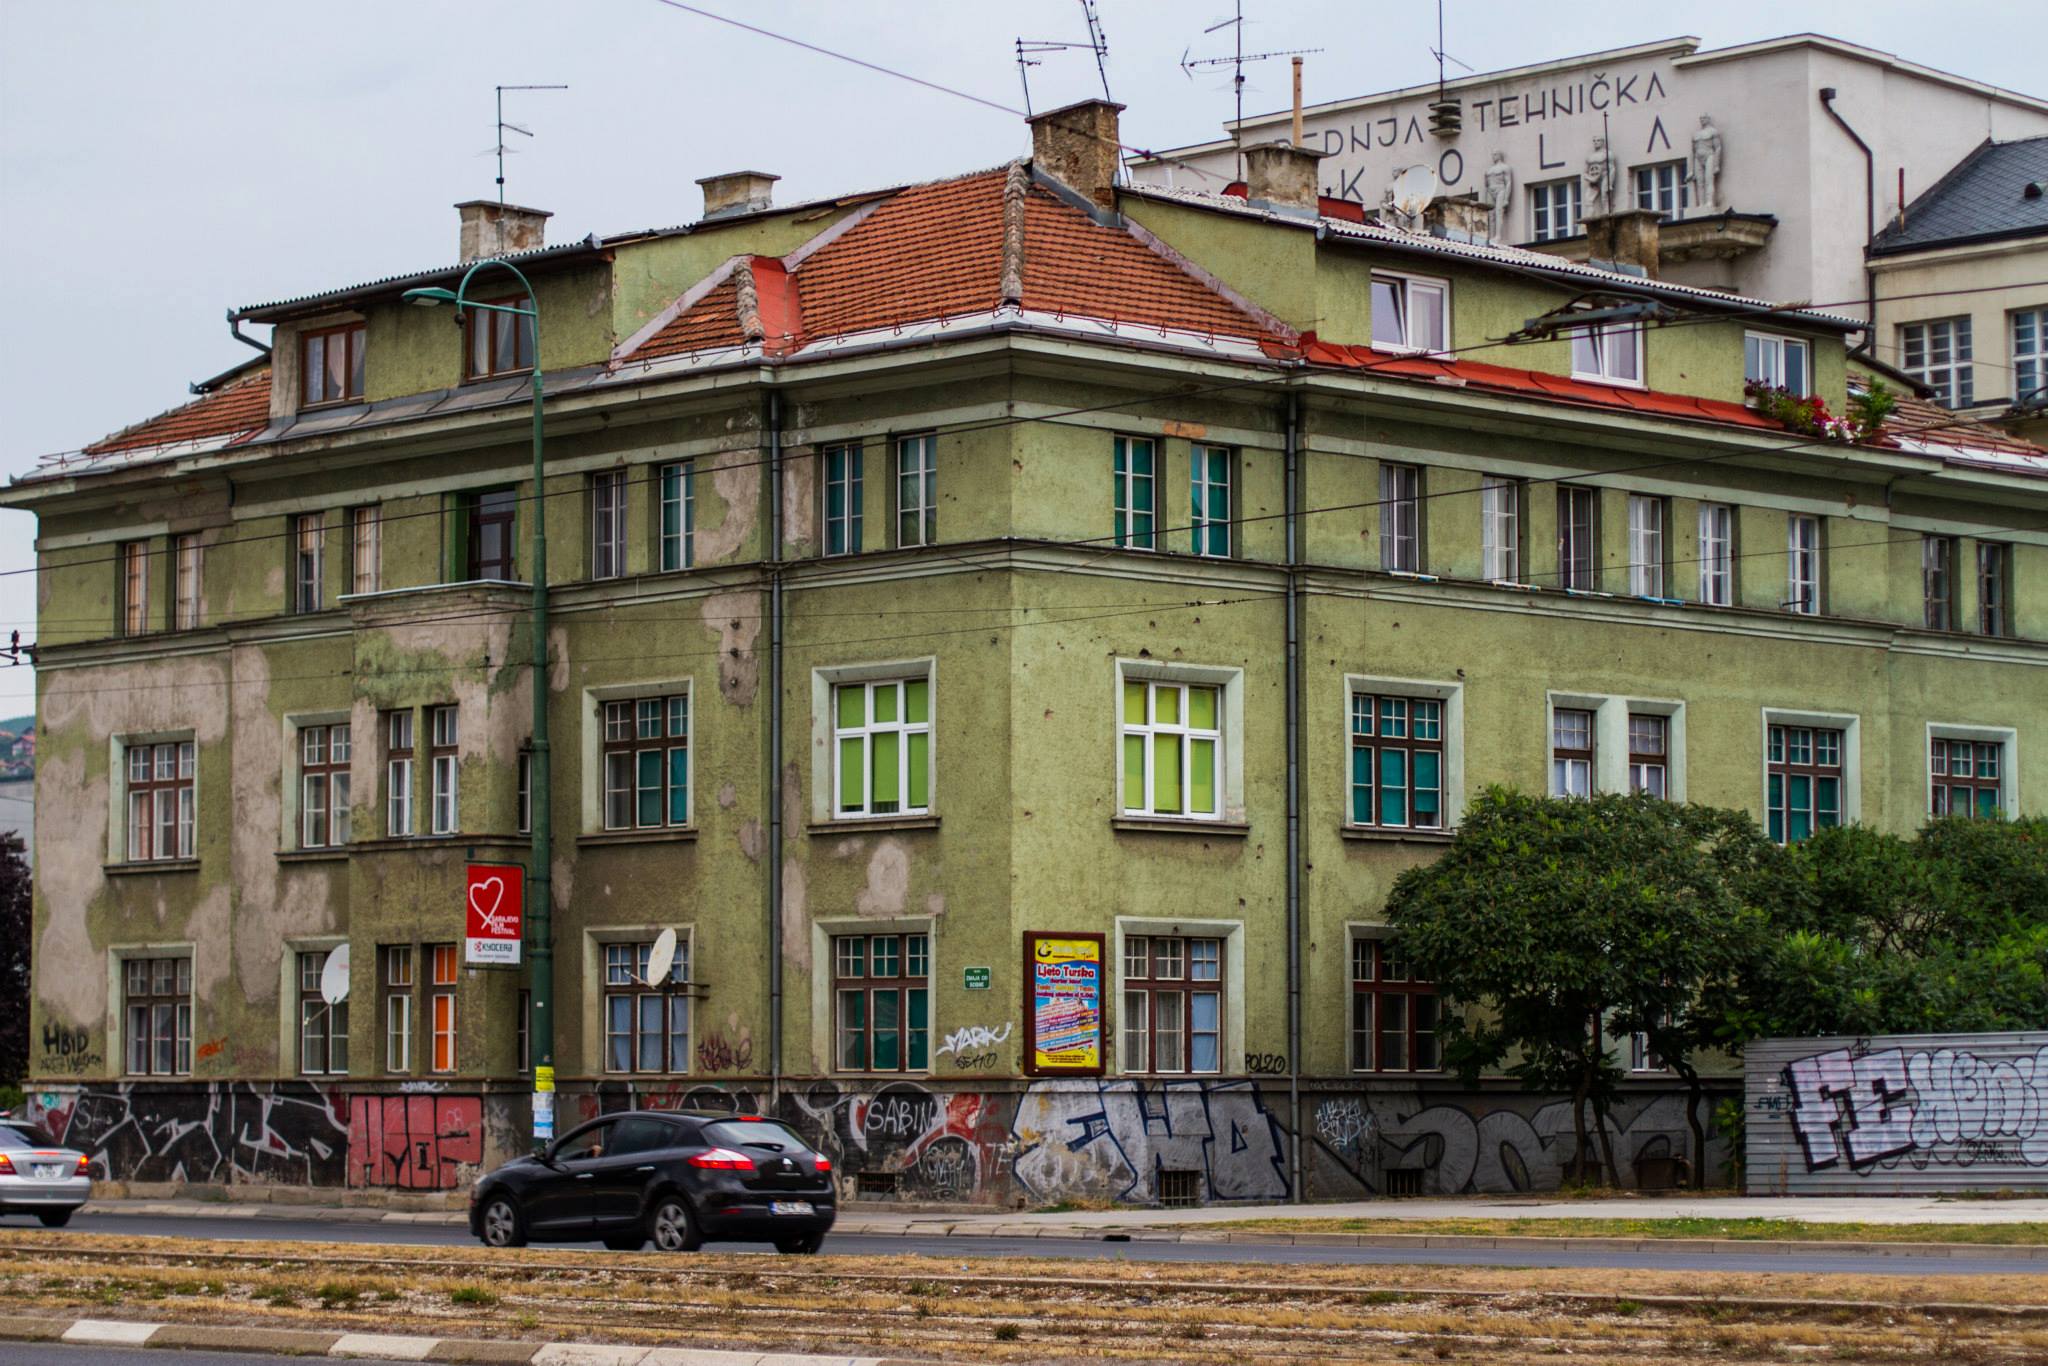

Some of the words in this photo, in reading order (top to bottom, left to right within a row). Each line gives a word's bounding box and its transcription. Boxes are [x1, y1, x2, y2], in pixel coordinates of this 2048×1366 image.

[1274, 115, 1424, 157] DNJA
[1471, 71, 1666, 133] TEHNIČKA
[482, 943, 513, 952] KYOCERA
[1037, 965, 1061, 978] Ljeto
[1063, 965, 1096, 978] Turska
